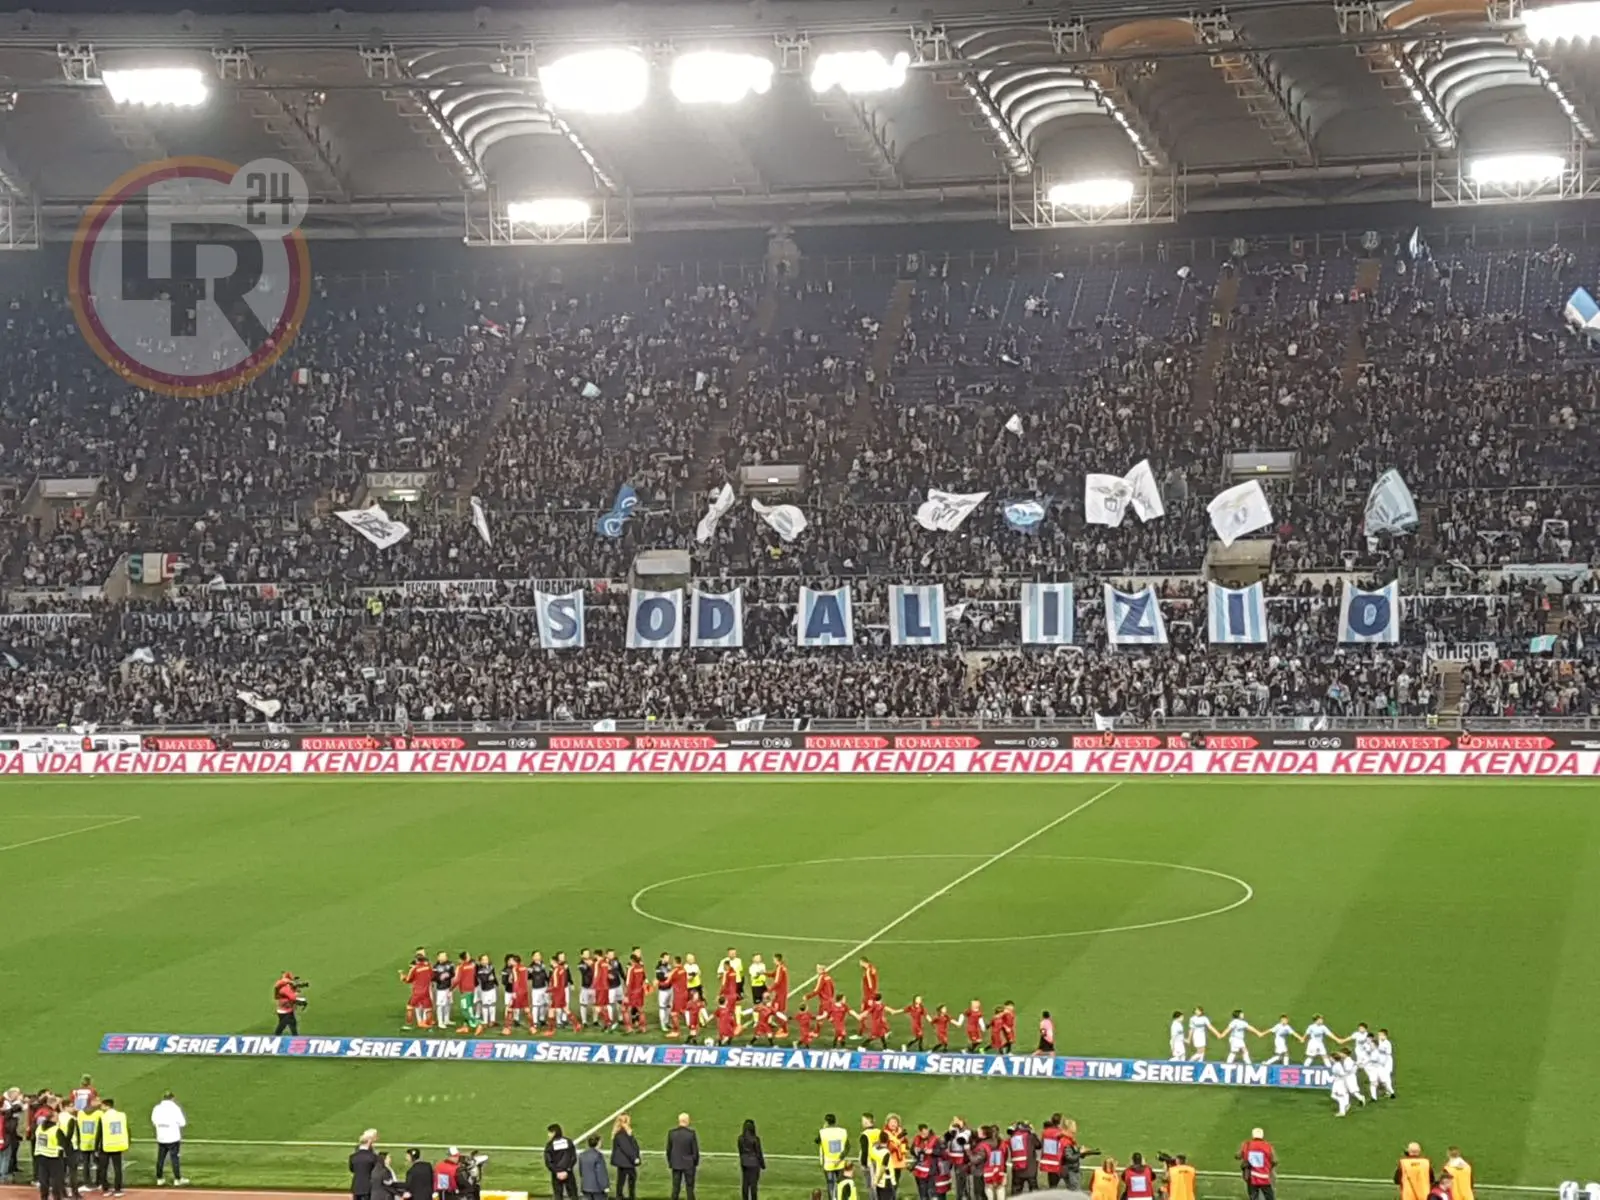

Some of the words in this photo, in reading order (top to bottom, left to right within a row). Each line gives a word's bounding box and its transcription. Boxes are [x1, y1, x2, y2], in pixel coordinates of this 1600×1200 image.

[372, 473, 426, 488] LAZIO
[302, 738, 367, 750] ROMAES
[548, 737, 622, 749] ROMAEST
[805, 737, 880, 749] ROMAEST
[895, 737, 971, 749] ROMAEST
[1356, 737, 1439, 749] ROMAEST
[1465, 737, 1543, 749] OMAEST
[93, 752, 187, 773] KENDA
[197, 752, 292, 773] KENDA
[303, 752, 399, 773] KENDA
[410, 752, 507, 773] KENDA
[517, 752, 615, 773] KENDA
[626, 752, 726, 773] KENDA
[737, 752, 839, 773] KENDA
[852, 752, 955, 773] KENDA
[968, 752, 1073, 773] KENDA
[1084, 752, 1193, 773] KENDA
[1207, 752, 1317, 773] KENDA
[1332, 752, 1446, 773] KENDA
[1460, 752, 1578, 773] KENDA
[127, 1036, 159, 1050] TIM
[163, 1036, 219, 1053] SERIE
[219, 1037, 238, 1053] A
[241, 1037, 281, 1054] TIM
[308, 1039, 341, 1053] TIM
[346, 1039, 403, 1056] SERIE
[404, 1040, 423, 1057] A
[425, 1040, 466, 1058] TIM
[494, 1043, 527, 1058] TIM
[533, 1042, 591, 1061] SERIE
[592, 1045, 611, 1062] A
[614, 1045, 654, 1064] TIM
[684, 1049, 719, 1064] TIM
[725, 1048, 785, 1067] SERIE
[786, 1051, 805, 1068] A
[807, 1051, 851, 1070] TIM
[882, 1055, 916, 1070] TIM
[925, 1054, 985, 1073] SERIE
[987, 1056, 1007, 1075] A
[1009, 1057, 1054, 1077] TIM
[1086, 1061, 1122, 1078] TIM
[1131, 1060, 1195, 1082] SERIE
[1197, 1062, 1219, 1083] A
[1220, 1063, 1268, 1084] TIM
